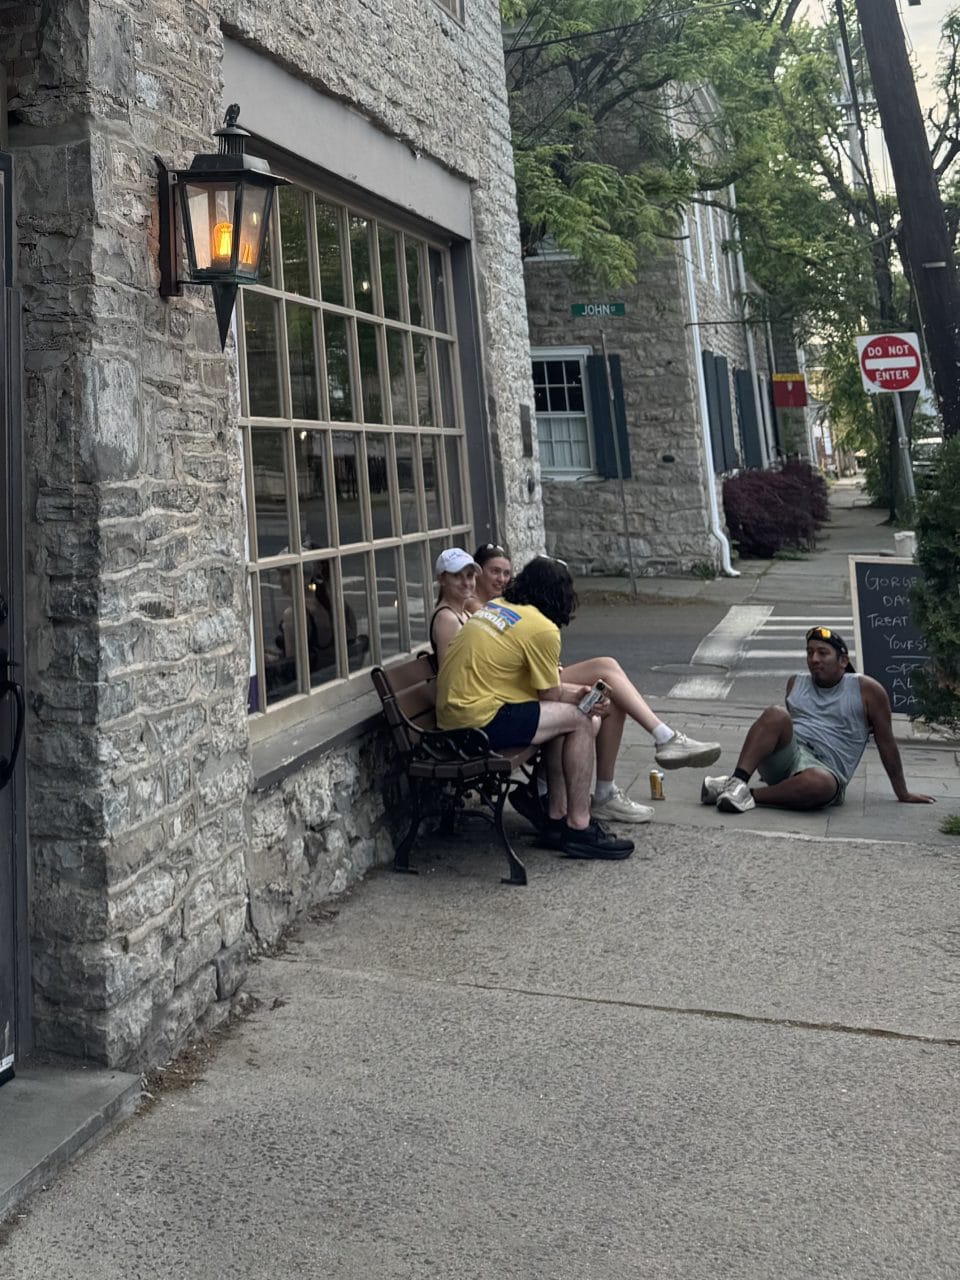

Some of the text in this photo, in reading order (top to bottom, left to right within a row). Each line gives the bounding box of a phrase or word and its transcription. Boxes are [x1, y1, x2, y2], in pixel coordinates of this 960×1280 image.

[581, 304, 610, 316] JOHN
[867, 345, 910, 357] DO NOT
[876, 370, 910, 381] ENTER
[883, 595, 910, 607] DA
[867, 613, 908, 628] TREAT
[894, 691, 918, 707] DA
